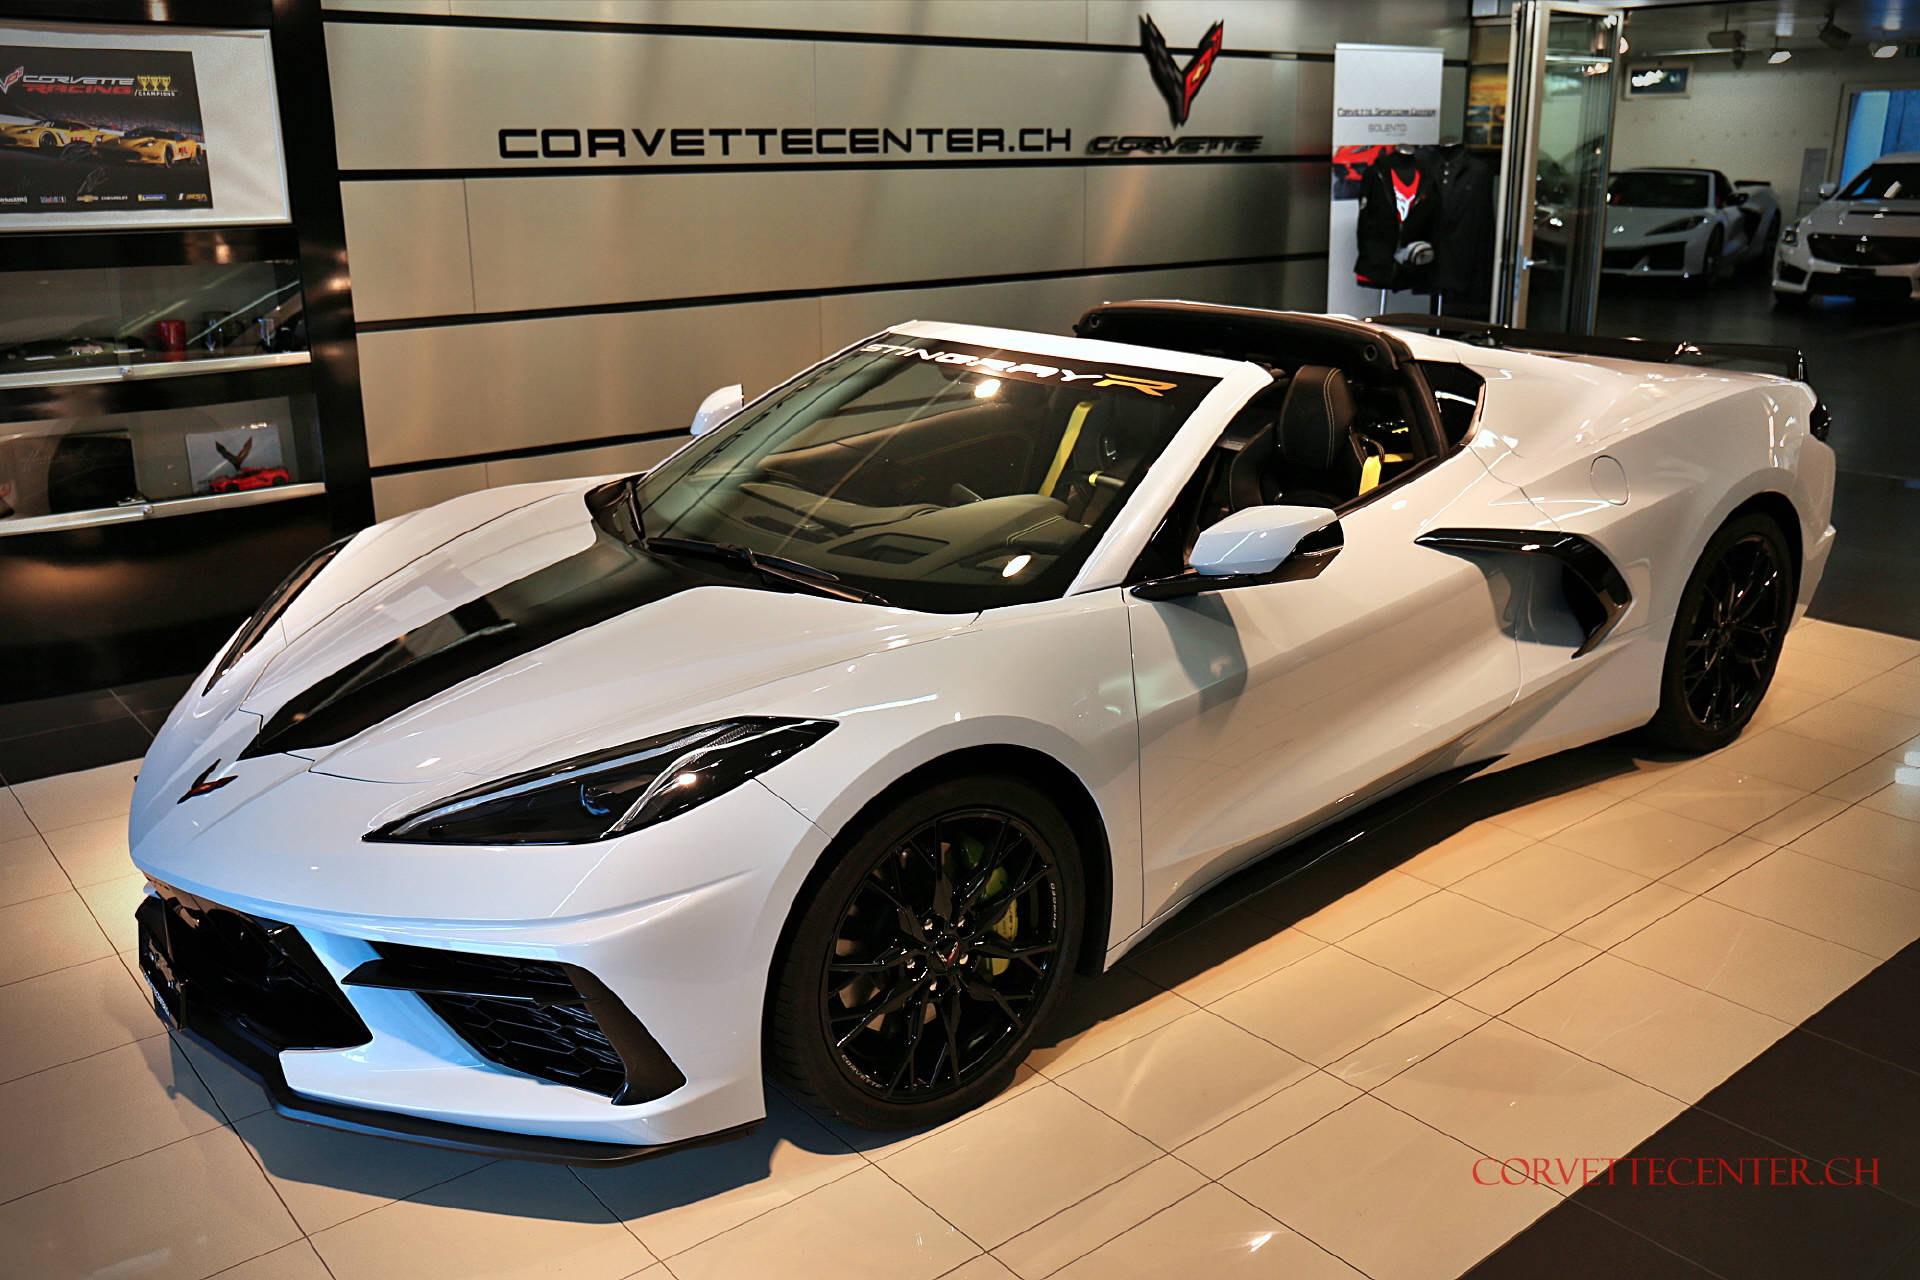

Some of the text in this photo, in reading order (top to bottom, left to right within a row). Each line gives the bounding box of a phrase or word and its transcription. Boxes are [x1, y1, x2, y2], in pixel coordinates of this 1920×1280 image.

[22, 74, 135, 86] CORVETTE
[23, 84, 133, 95] RACING
[498, 127, 1072, 159] CORVETTECENTER.CH
[1088, 135, 1264, 155] CORVETTE
[860, 343, 1178, 397] STINGRAY R
